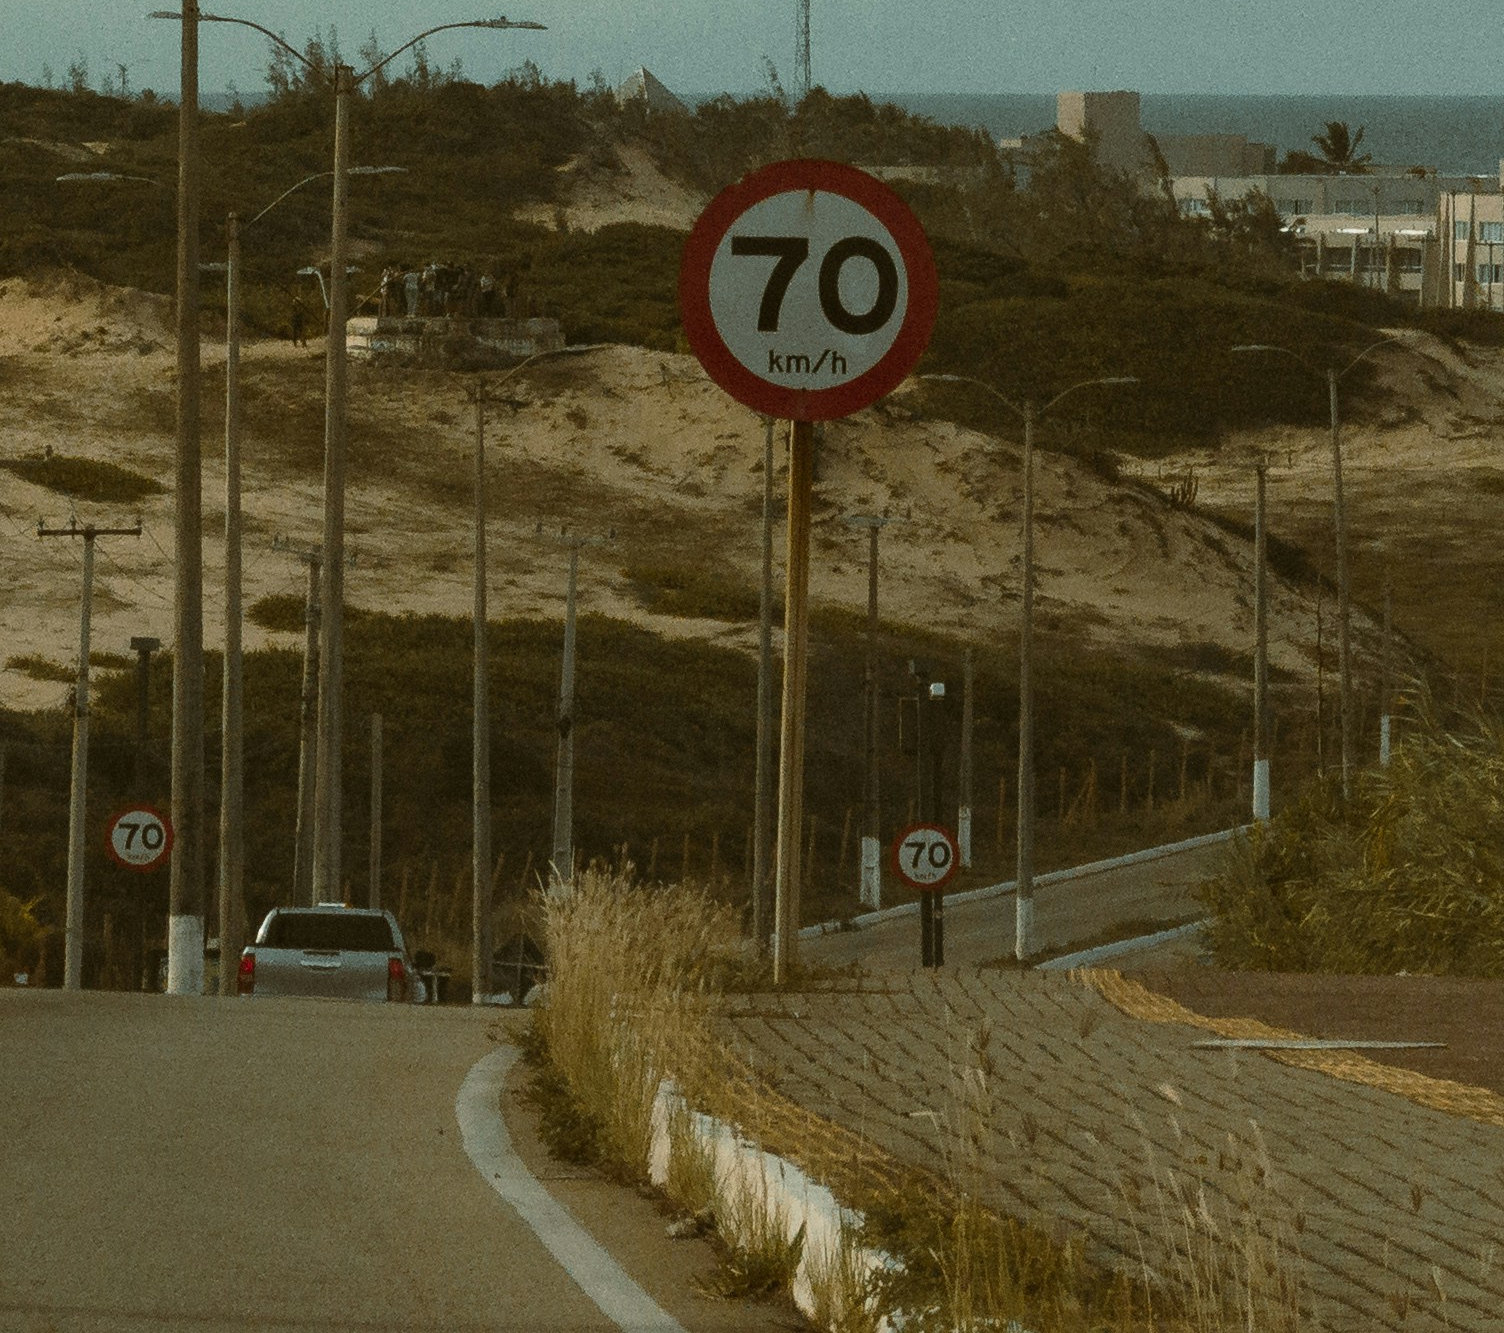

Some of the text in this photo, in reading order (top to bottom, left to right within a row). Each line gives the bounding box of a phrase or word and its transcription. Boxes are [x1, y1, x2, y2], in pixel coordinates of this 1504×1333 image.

[731, 236, 899, 336] 70
[768, 349, 847, 375] km/h
[118, 823, 164, 850] 70
[905, 841, 951, 869] 70
